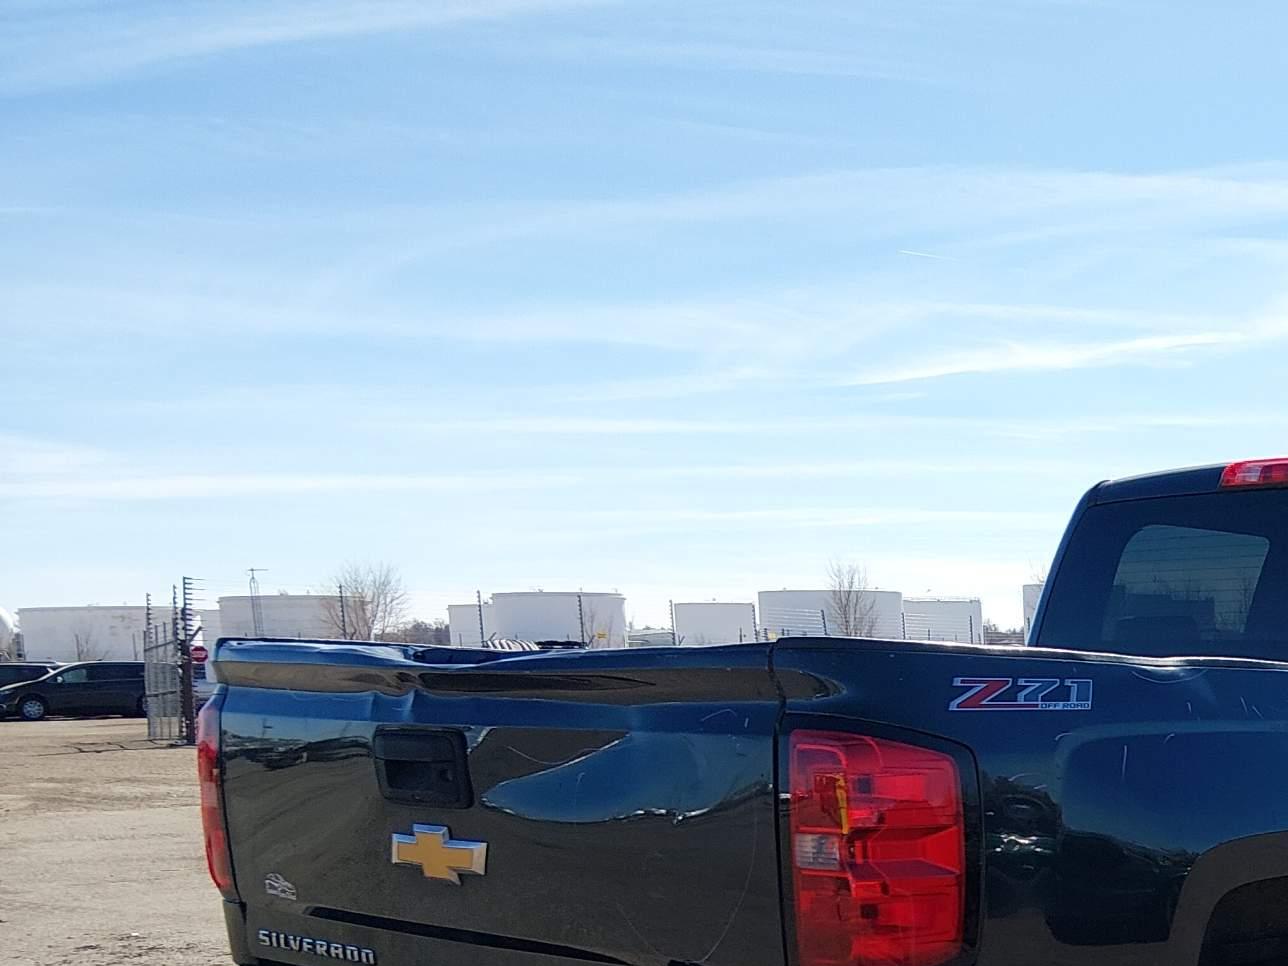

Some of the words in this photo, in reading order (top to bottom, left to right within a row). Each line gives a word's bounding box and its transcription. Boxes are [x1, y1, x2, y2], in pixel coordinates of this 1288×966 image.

[948, 677, 1093, 711] Z71
[1040, 702, 1060, 710] OFF
[1062, 702, 1090, 710] ROAD
[258, 929, 377, 966] SILVERADO
